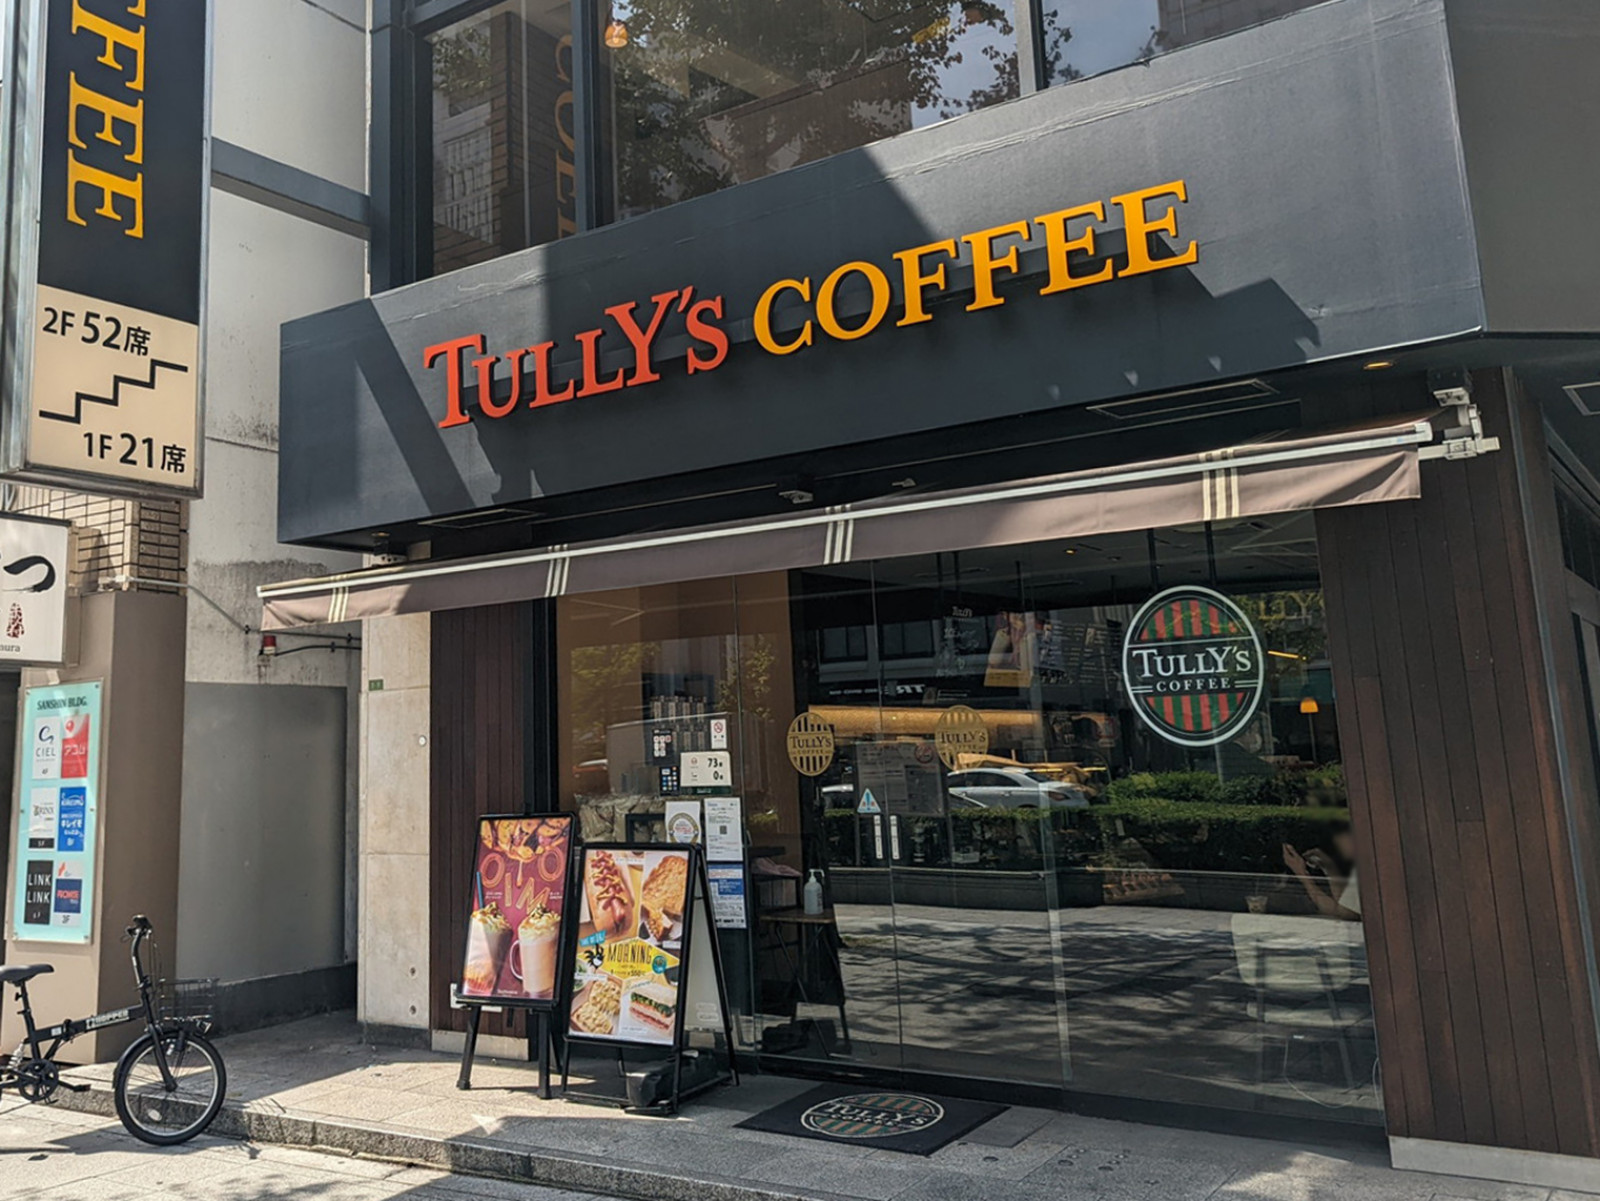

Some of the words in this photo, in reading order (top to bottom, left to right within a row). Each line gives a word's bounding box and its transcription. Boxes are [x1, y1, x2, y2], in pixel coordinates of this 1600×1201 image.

[67, 0, 147, 238] FEE
[752, 179, 1199, 356] COFFEE
[80, 311, 152, 357] 52席
[119, 433, 187, 474] 21席
[1155, 677, 1231, 692] COFFEE
[36, 746, 56, 757] CIEL
[28, 873, 52, 887] LINK
[26, 891, 50, 904] LINK
[606, 942, 654, 965] MORNING
